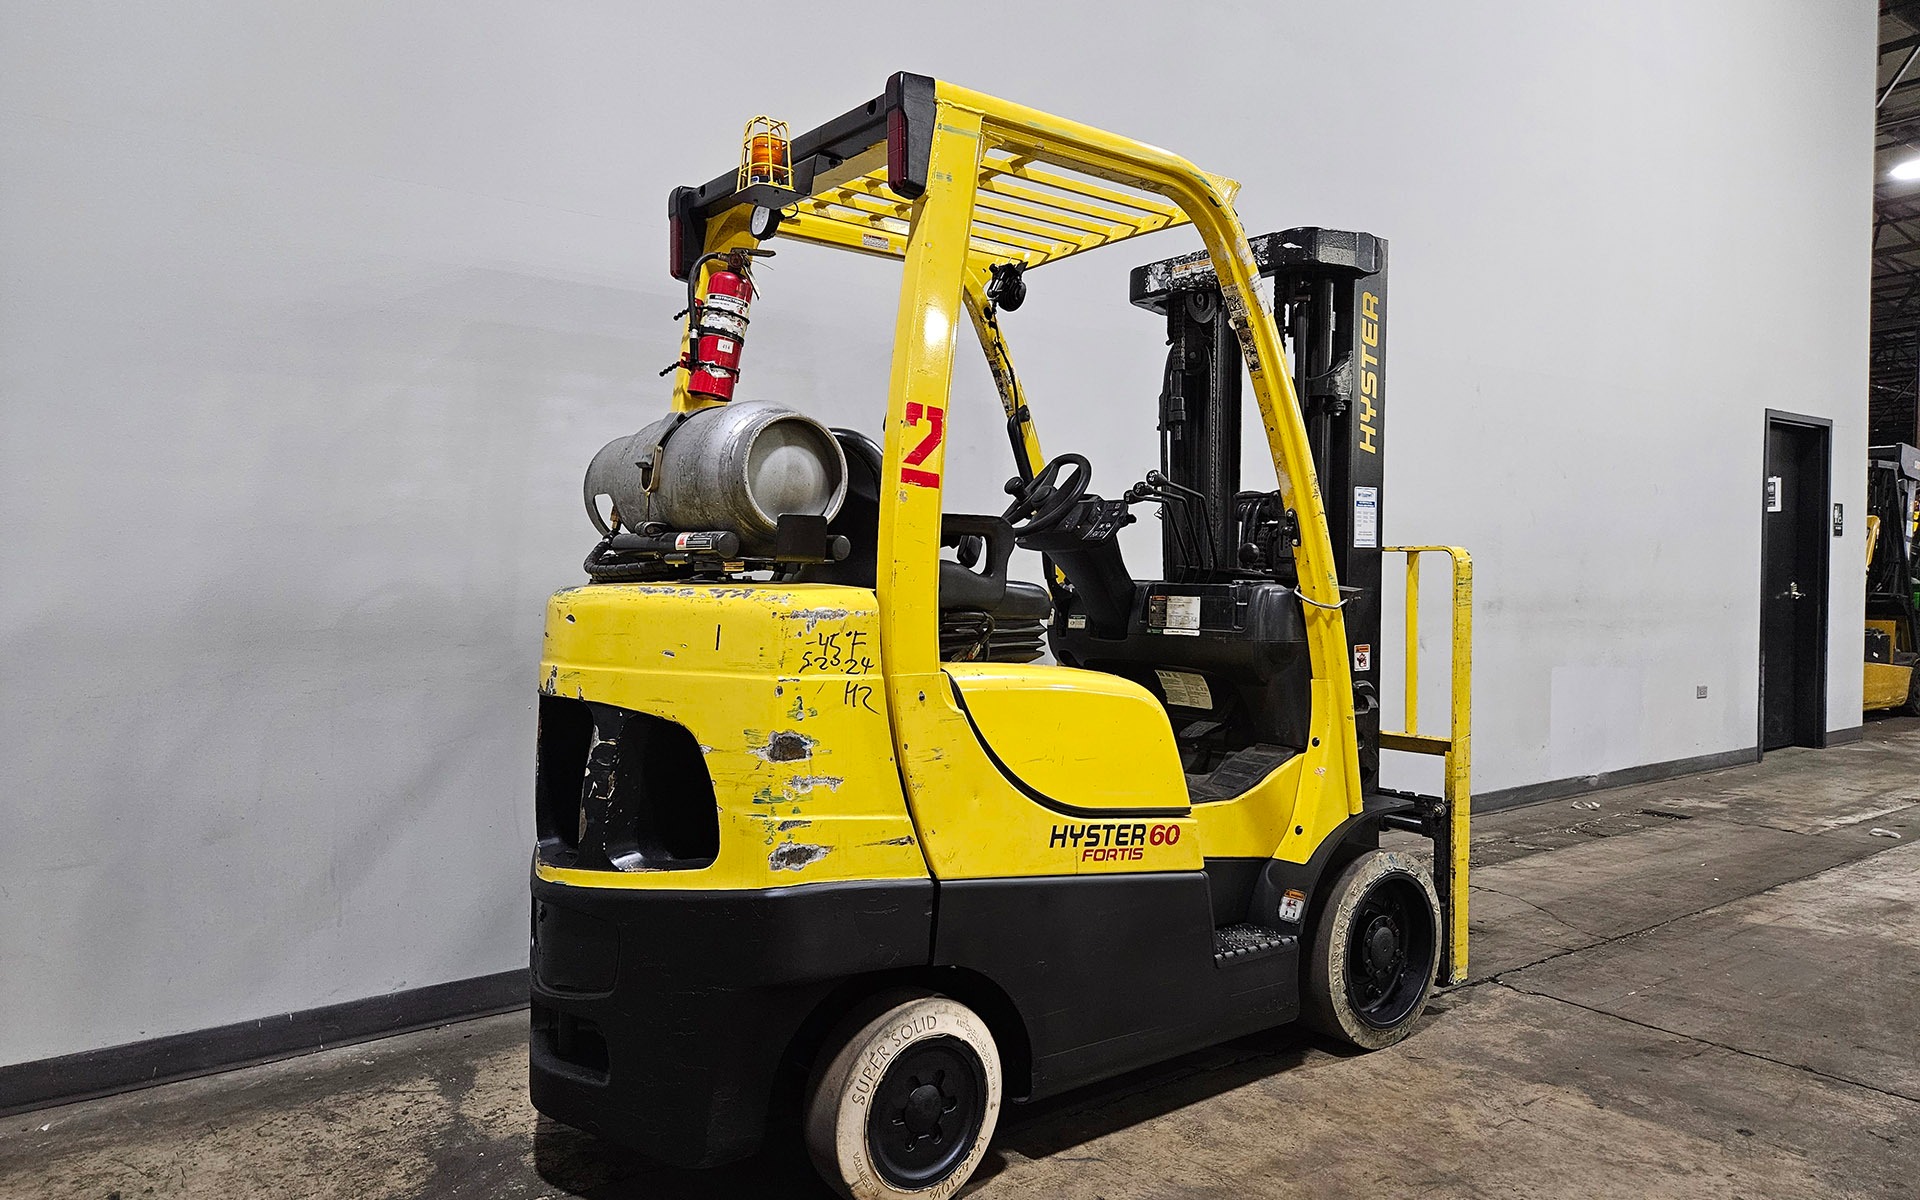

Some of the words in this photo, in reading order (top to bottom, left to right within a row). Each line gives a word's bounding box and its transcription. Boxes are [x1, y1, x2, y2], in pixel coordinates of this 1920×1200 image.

[1360, 291, 1379, 454] HYSTER
[1049, 824, 1147, 848] HYSTER
[1149, 824, 1181, 846] 60
[1081, 847, 1144, 862] FORTIS
[852, 1045, 890, 1106] SUPER
[891, 1015, 937, 1048] SOLID
